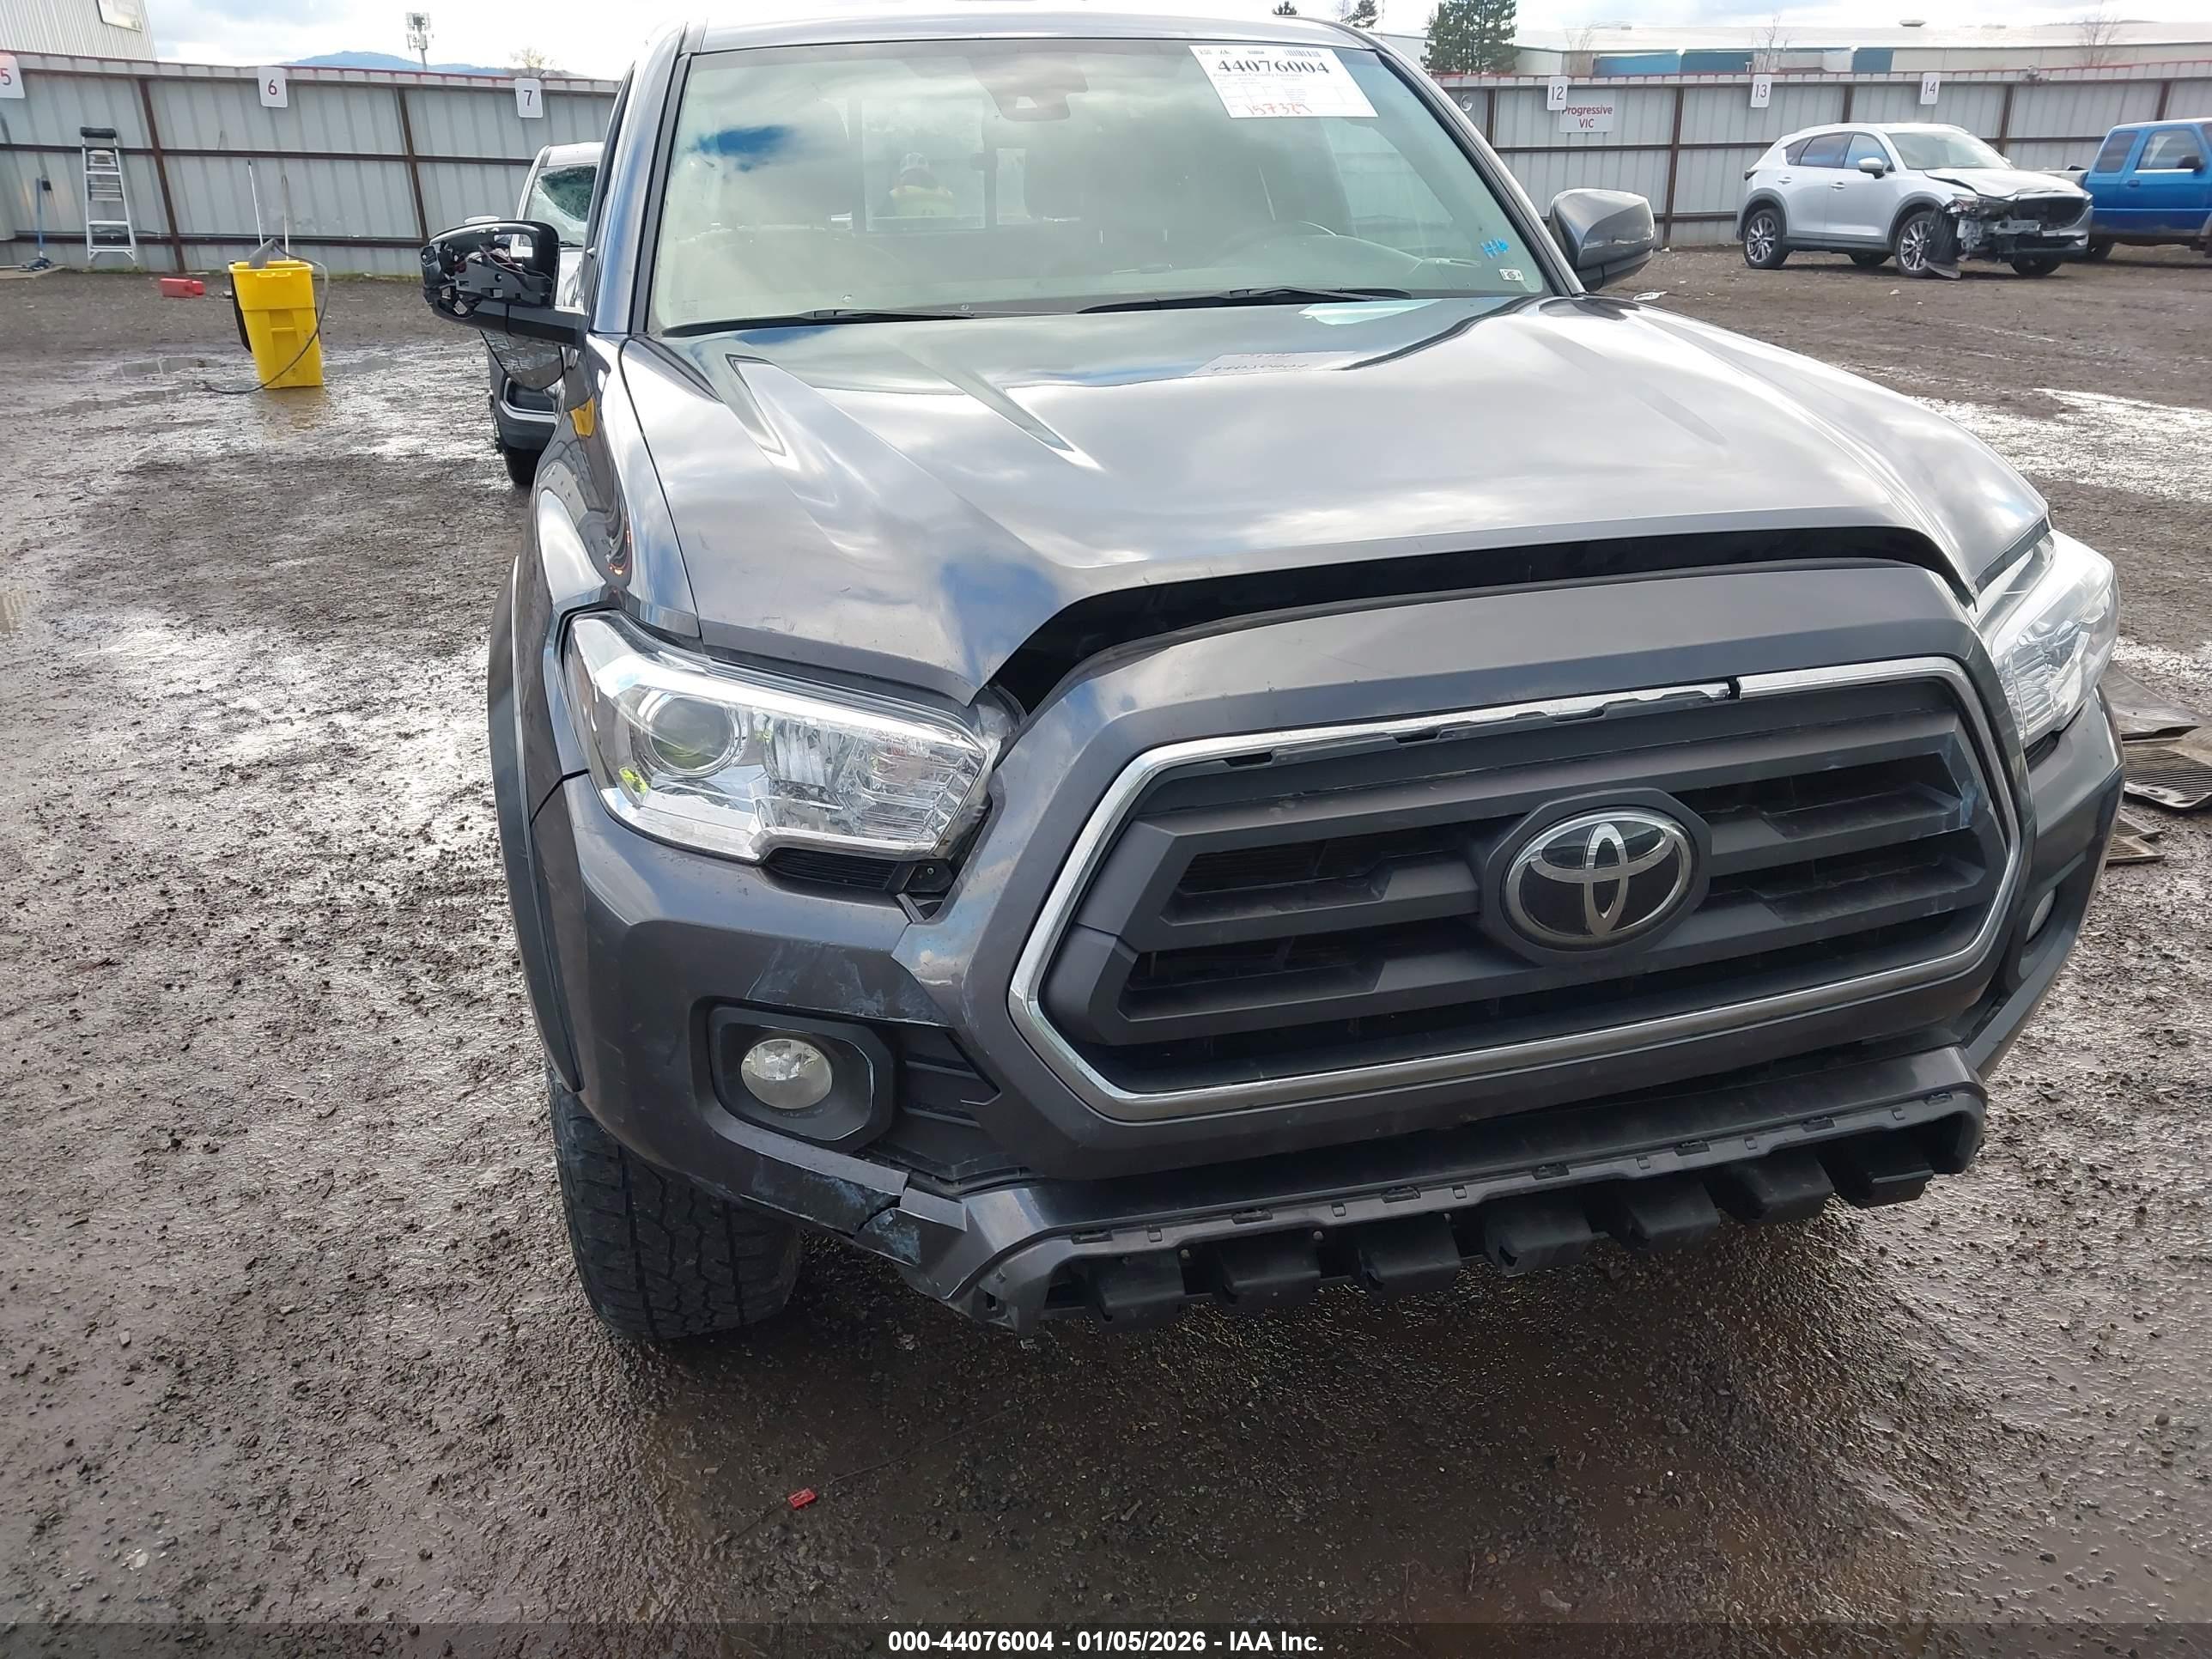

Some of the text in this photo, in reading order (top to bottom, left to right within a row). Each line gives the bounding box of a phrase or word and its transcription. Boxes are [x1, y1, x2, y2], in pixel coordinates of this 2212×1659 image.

[1218, 60, 1330, 74] 44076004
[0, 68, 12, 86] 5
[268, 79, 277, 95] 6
[1552, 86, 1564, 100] 12
[1755, 84, 1767, 98] 13
[1924, 82, 1936, 94] 14
[524, 89, 532, 106] 7
[1579, 118, 1595, 128] VIC
